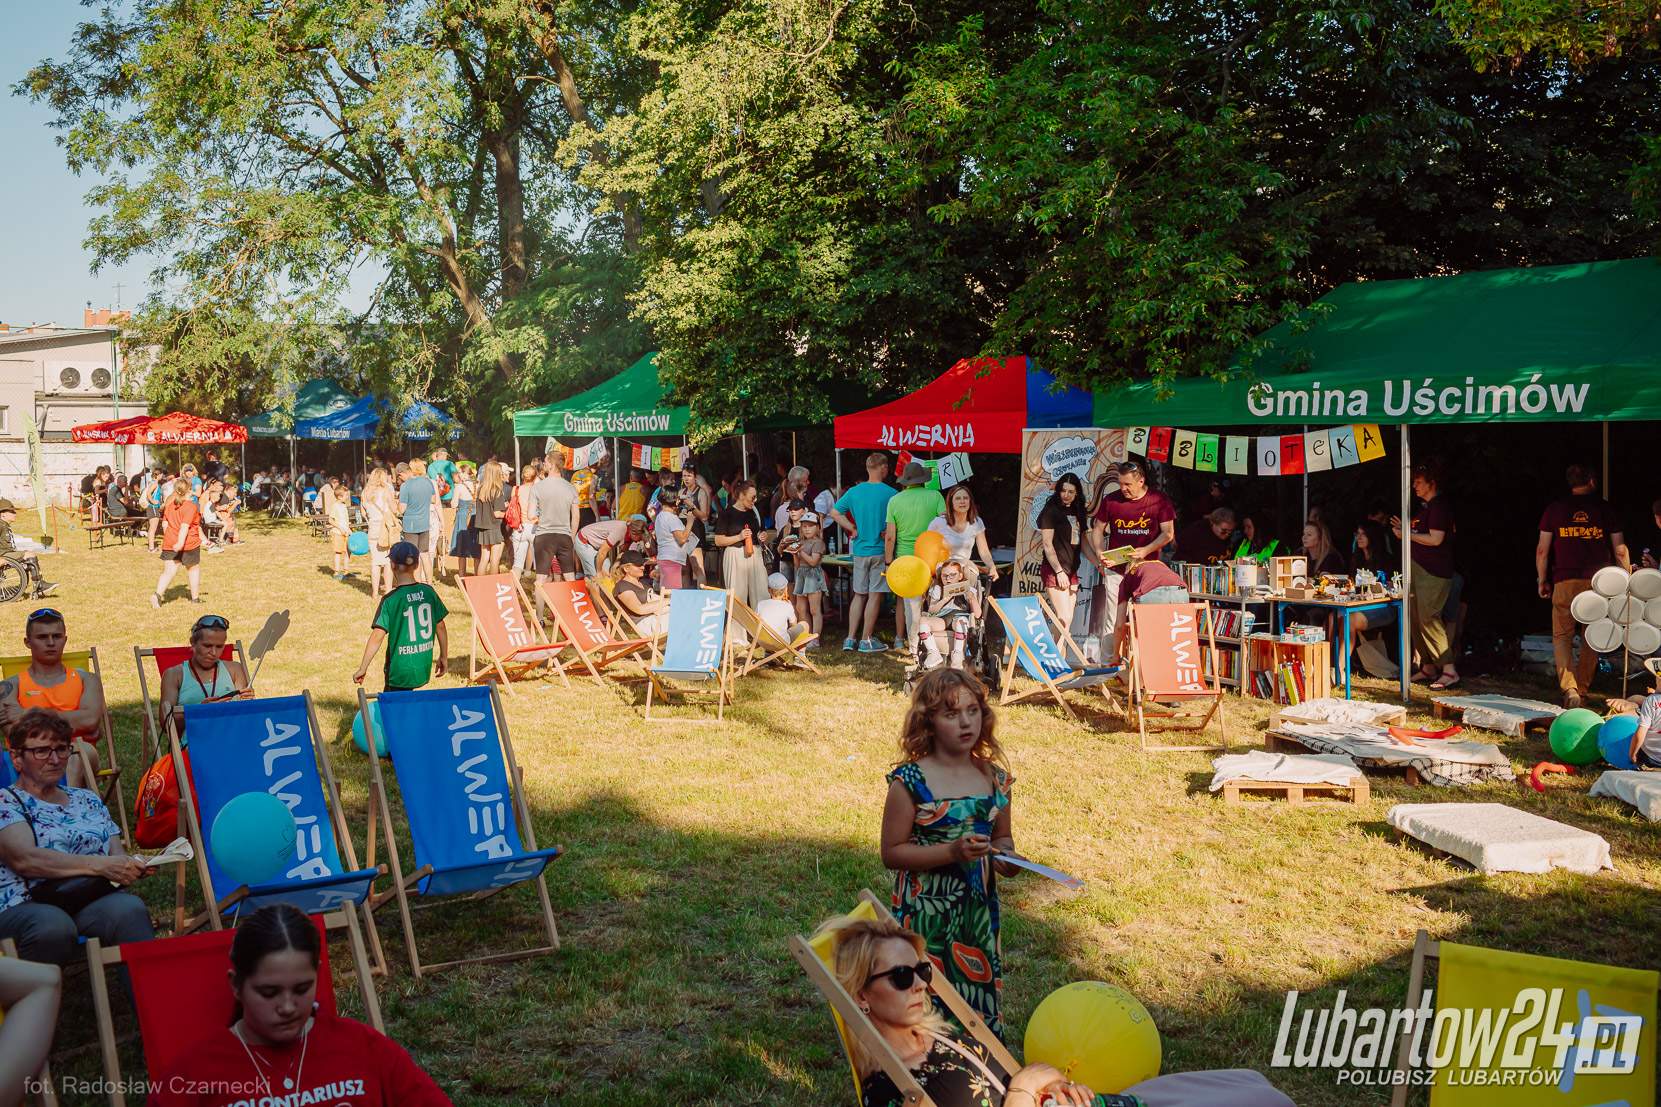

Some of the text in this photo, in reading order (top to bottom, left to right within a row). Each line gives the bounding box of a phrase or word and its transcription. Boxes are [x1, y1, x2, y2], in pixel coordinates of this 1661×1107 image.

[1247, 373, 1590, 417] Gmina Uścimów
[564, 409, 670, 432] Gmina Uścimów
[161, 431, 219, 442] ALWERNIA
[877, 422, 975, 448] ALWERNIA
[1132, 427, 1377, 467] BIBLIOTEKA
[403, 603, 433, 642] 19
[399, 645, 418, 655] PERŁA
